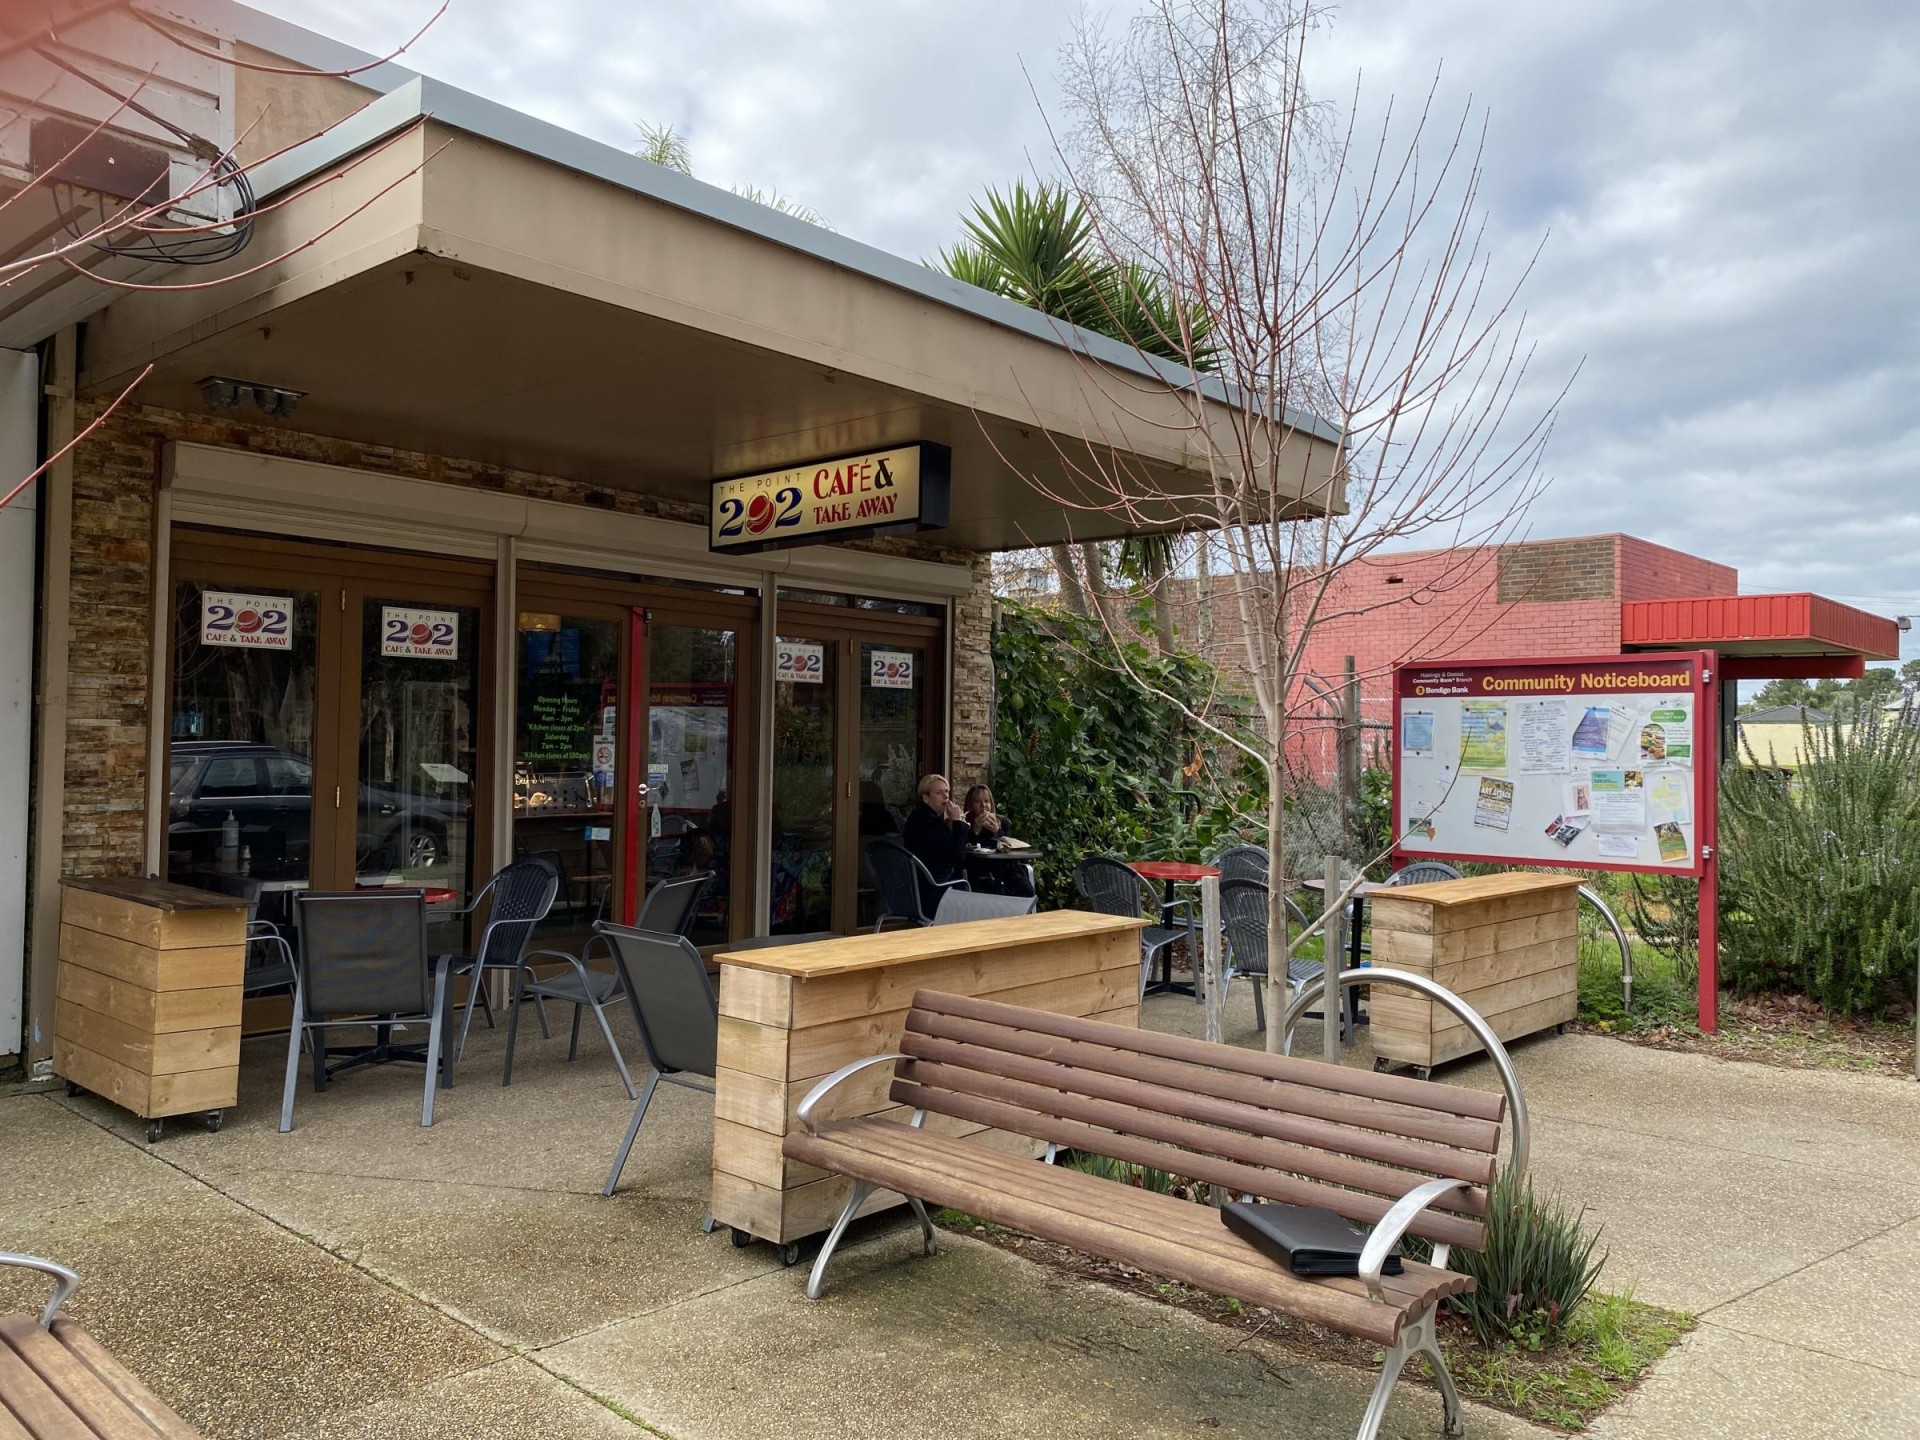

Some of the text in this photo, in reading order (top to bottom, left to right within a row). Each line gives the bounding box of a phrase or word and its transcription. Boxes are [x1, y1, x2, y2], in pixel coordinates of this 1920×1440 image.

[719, 473, 801, 495] THE POINT
[813, 457, 894, 500] CAFÉ &
[813, 493, 898, 525] TAKE AWAY
[207, 597, 287, 608] THE POINT
[387, 612, 454, 623] THE POINT
[240, 635, 262, 644] TAKE
[264, 637, 288, 645] AWAY
[434, 648, 454, 656] AWAY
[1482, 671, 1690, 692] Community Noticeboard
[538, 696, 560, 705] Opening
[533, 704, 556, 714] Monday
[562, 706, 580, 715] Friday
[544, 733, 570, 743] Saturday
